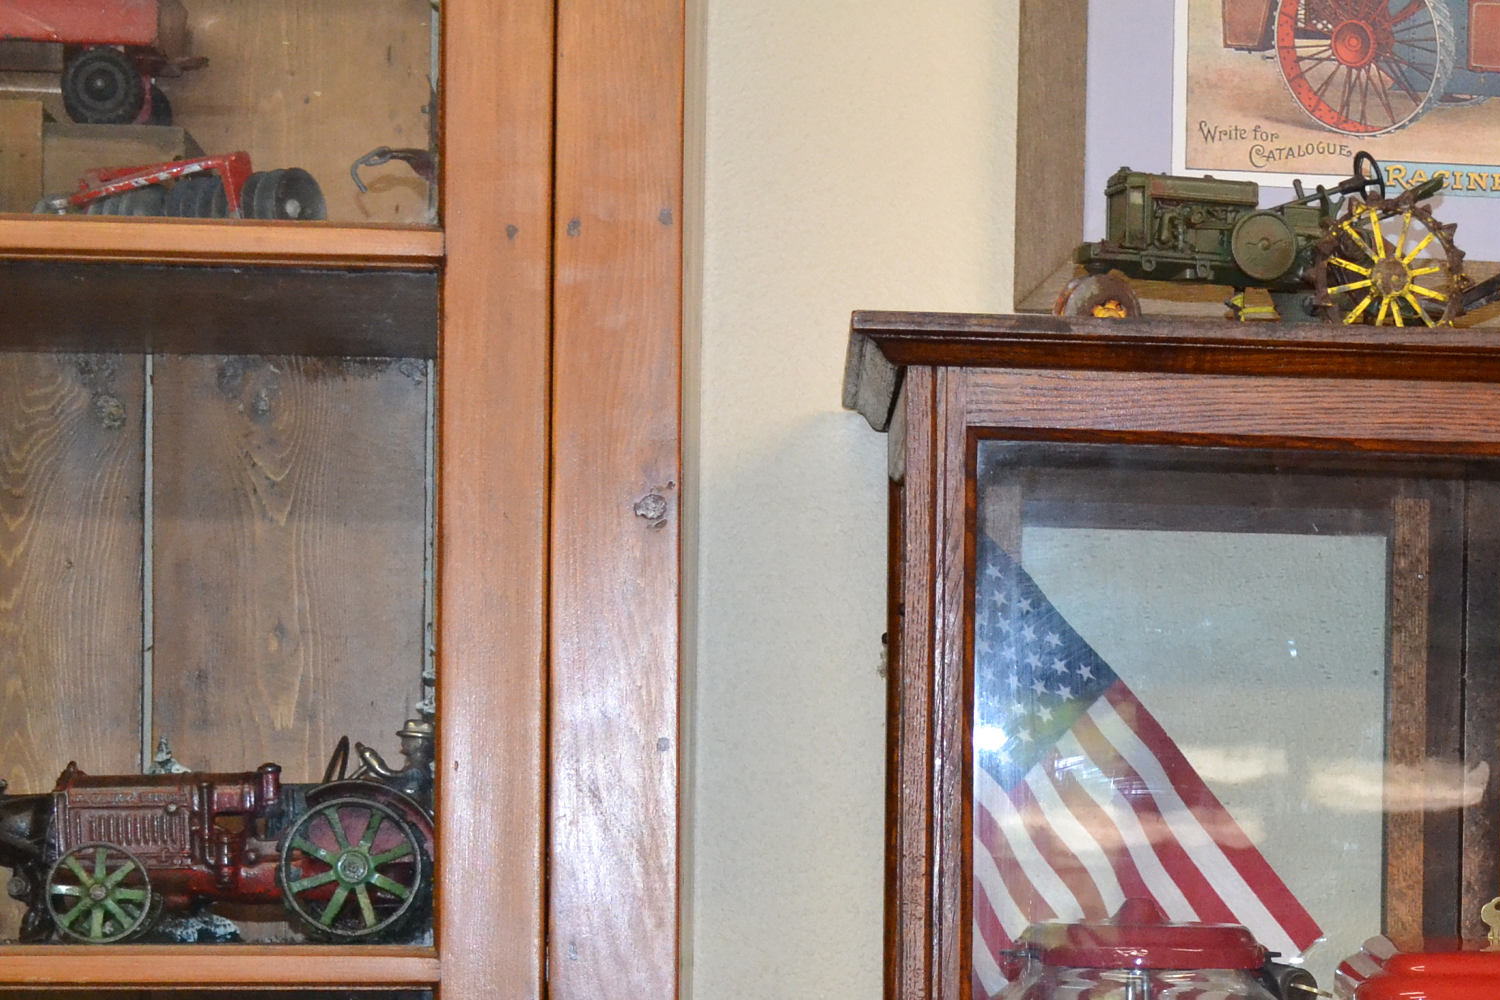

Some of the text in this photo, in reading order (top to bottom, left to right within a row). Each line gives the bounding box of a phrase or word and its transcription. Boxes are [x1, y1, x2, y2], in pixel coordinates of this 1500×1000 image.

[1199, 120, 1280, 144] Write for
[1249, 141, 1353, 168] CATALOGUE
